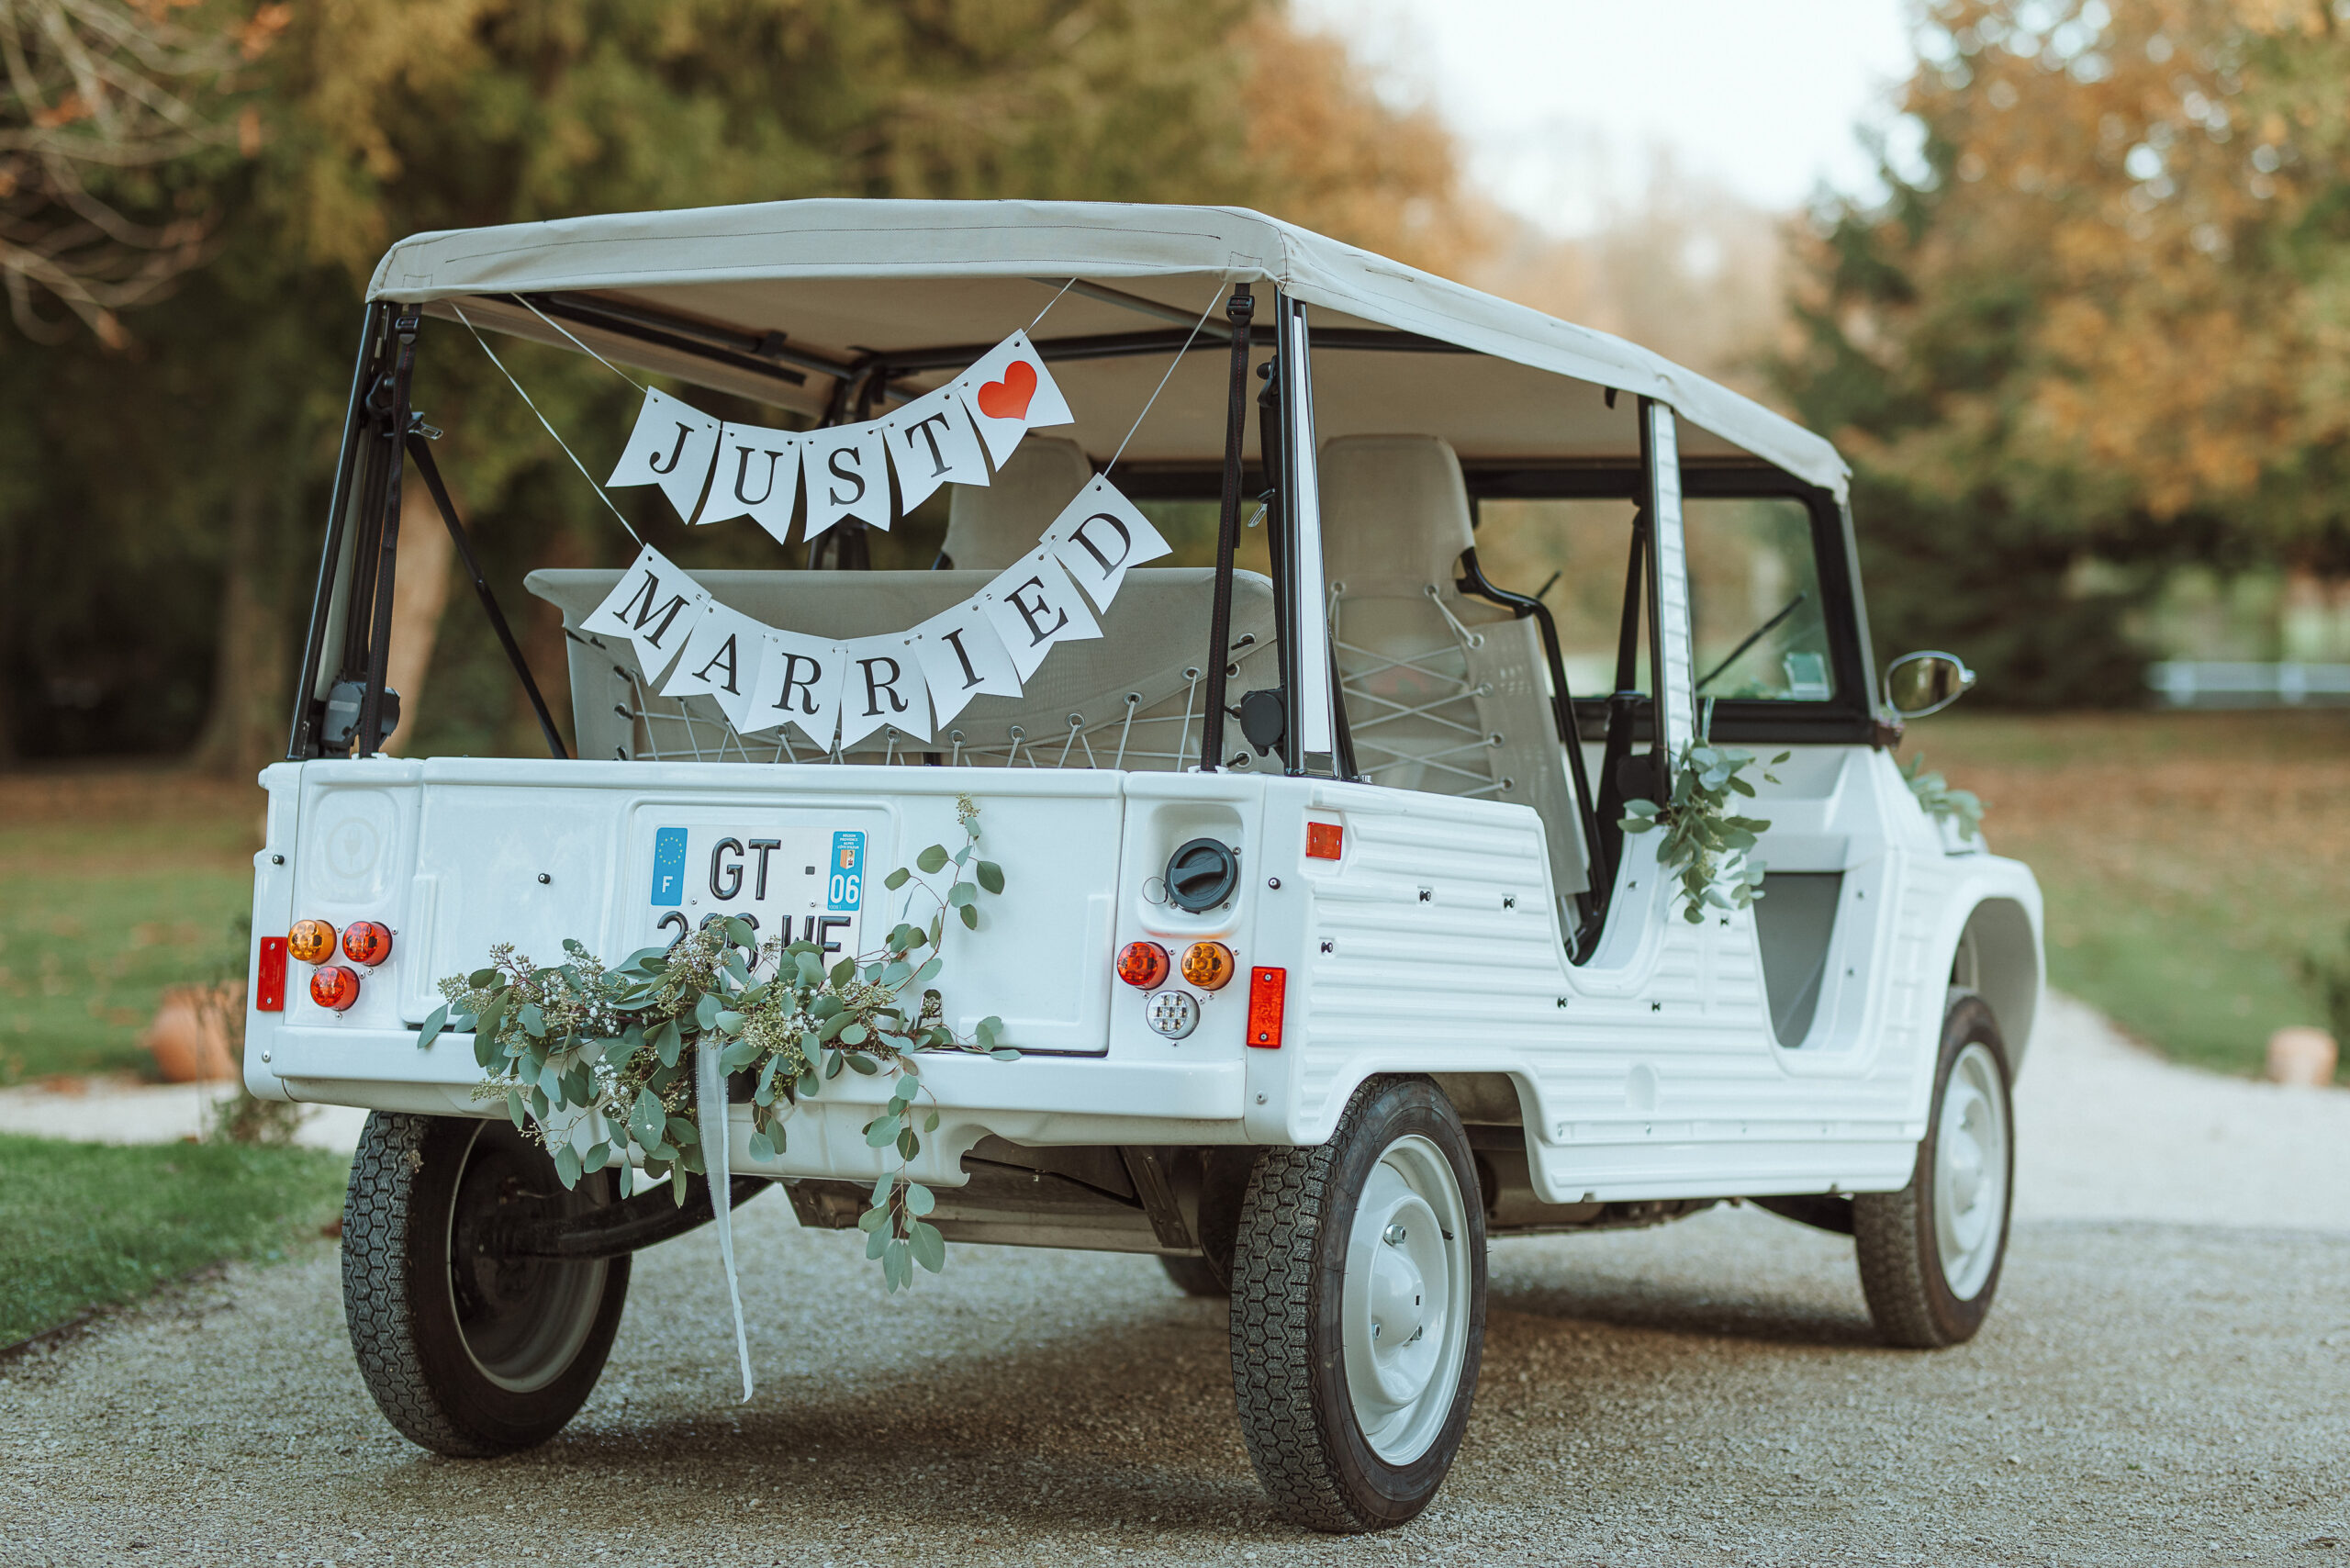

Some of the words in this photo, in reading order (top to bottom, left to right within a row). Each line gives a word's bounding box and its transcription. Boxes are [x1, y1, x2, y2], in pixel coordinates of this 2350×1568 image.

[649, 411, 953, 506] JUST
[612, 512, 1131, 717] MARRIED
[661, 875, 674, 894] F
[829, 873, 860, 904] 06
